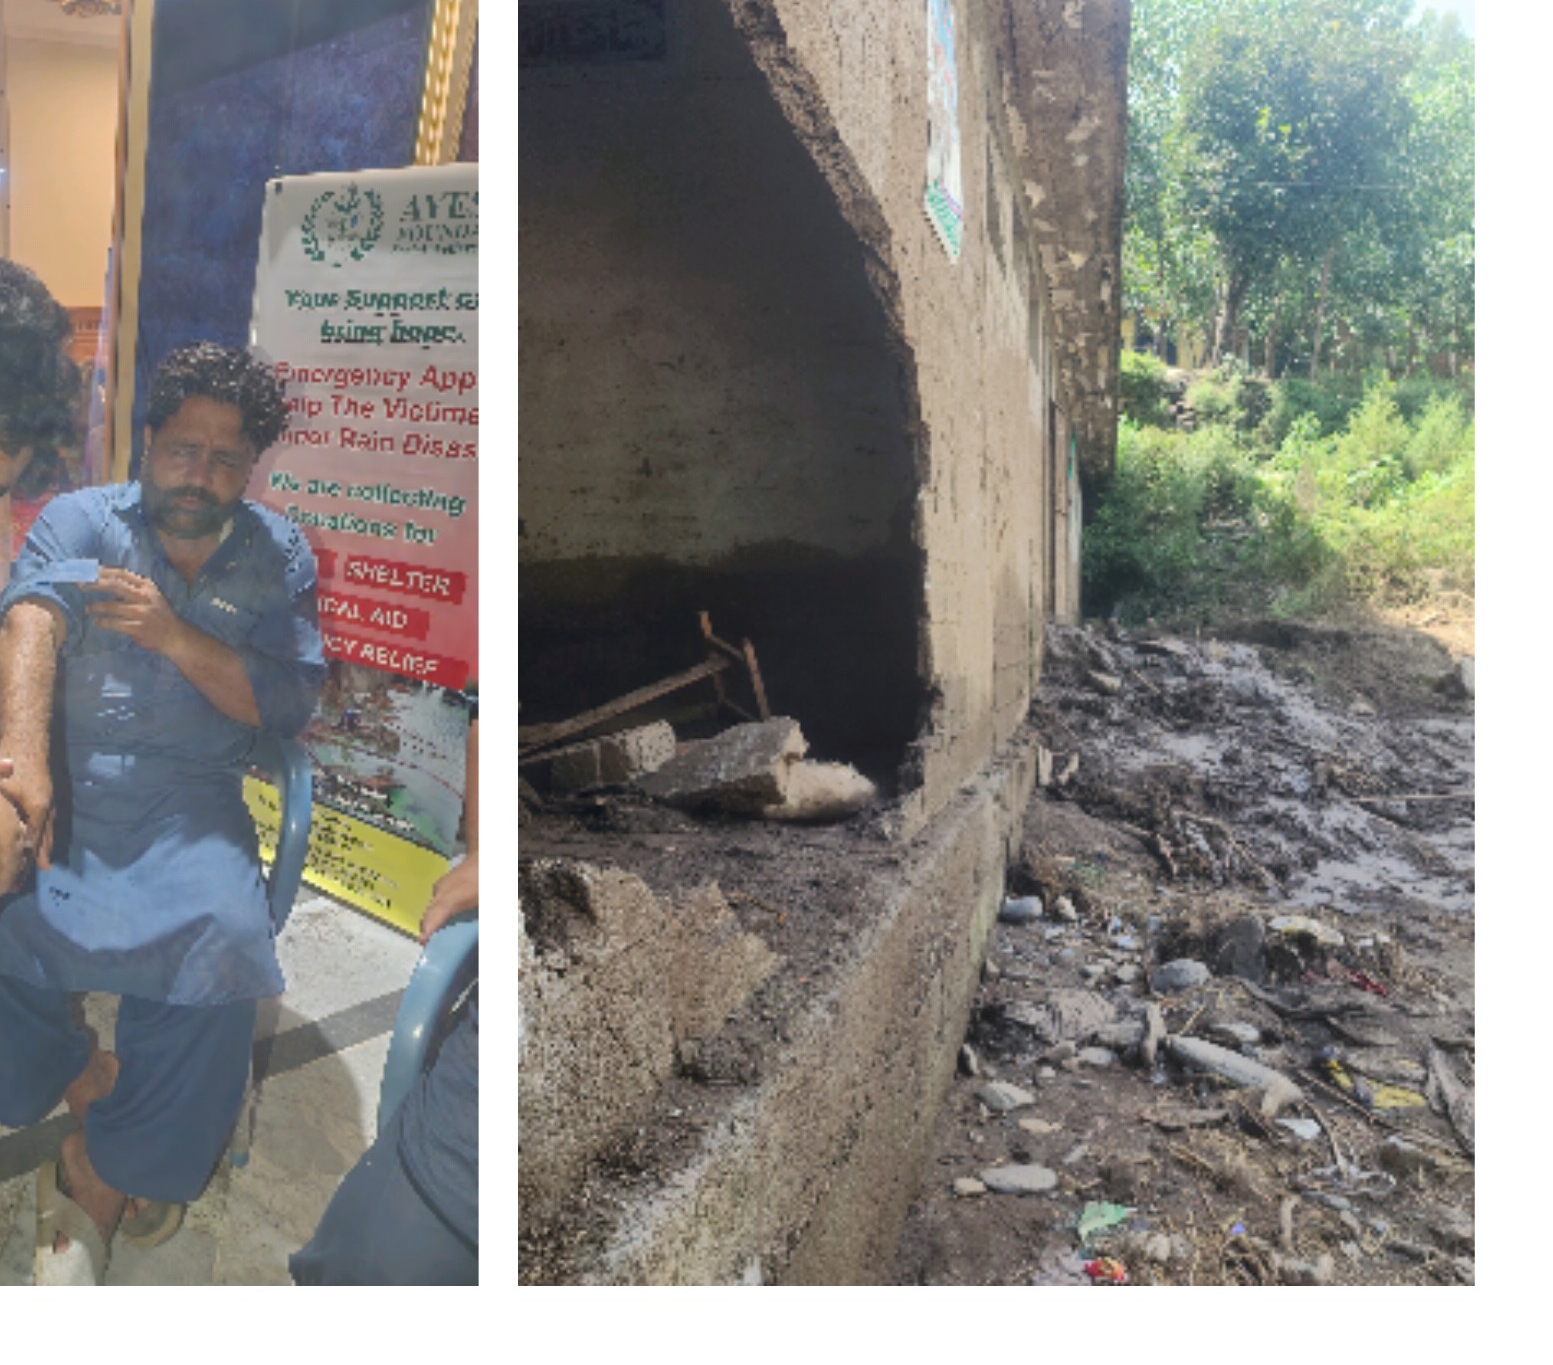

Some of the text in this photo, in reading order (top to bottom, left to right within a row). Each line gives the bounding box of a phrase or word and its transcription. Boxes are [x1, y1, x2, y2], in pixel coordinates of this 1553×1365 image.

[285, 287, 448, 317] Your Support
[320, 319, 383, 346] bring
[274, 361, 412, 393] Emergency
[330, 394, 376, 421] The
[280, 426, 330, 448] uner
[339, 426, 395, 453] Rain
[306, 477, 343, 499] are
[347, 480, 467, 517] collecting
[403, 519, 439, 546] for
[346, 557, 452, 597] SHELTER
[370, 605, 410, 631] AID
[359, 641, 440, 677] RELIEF
